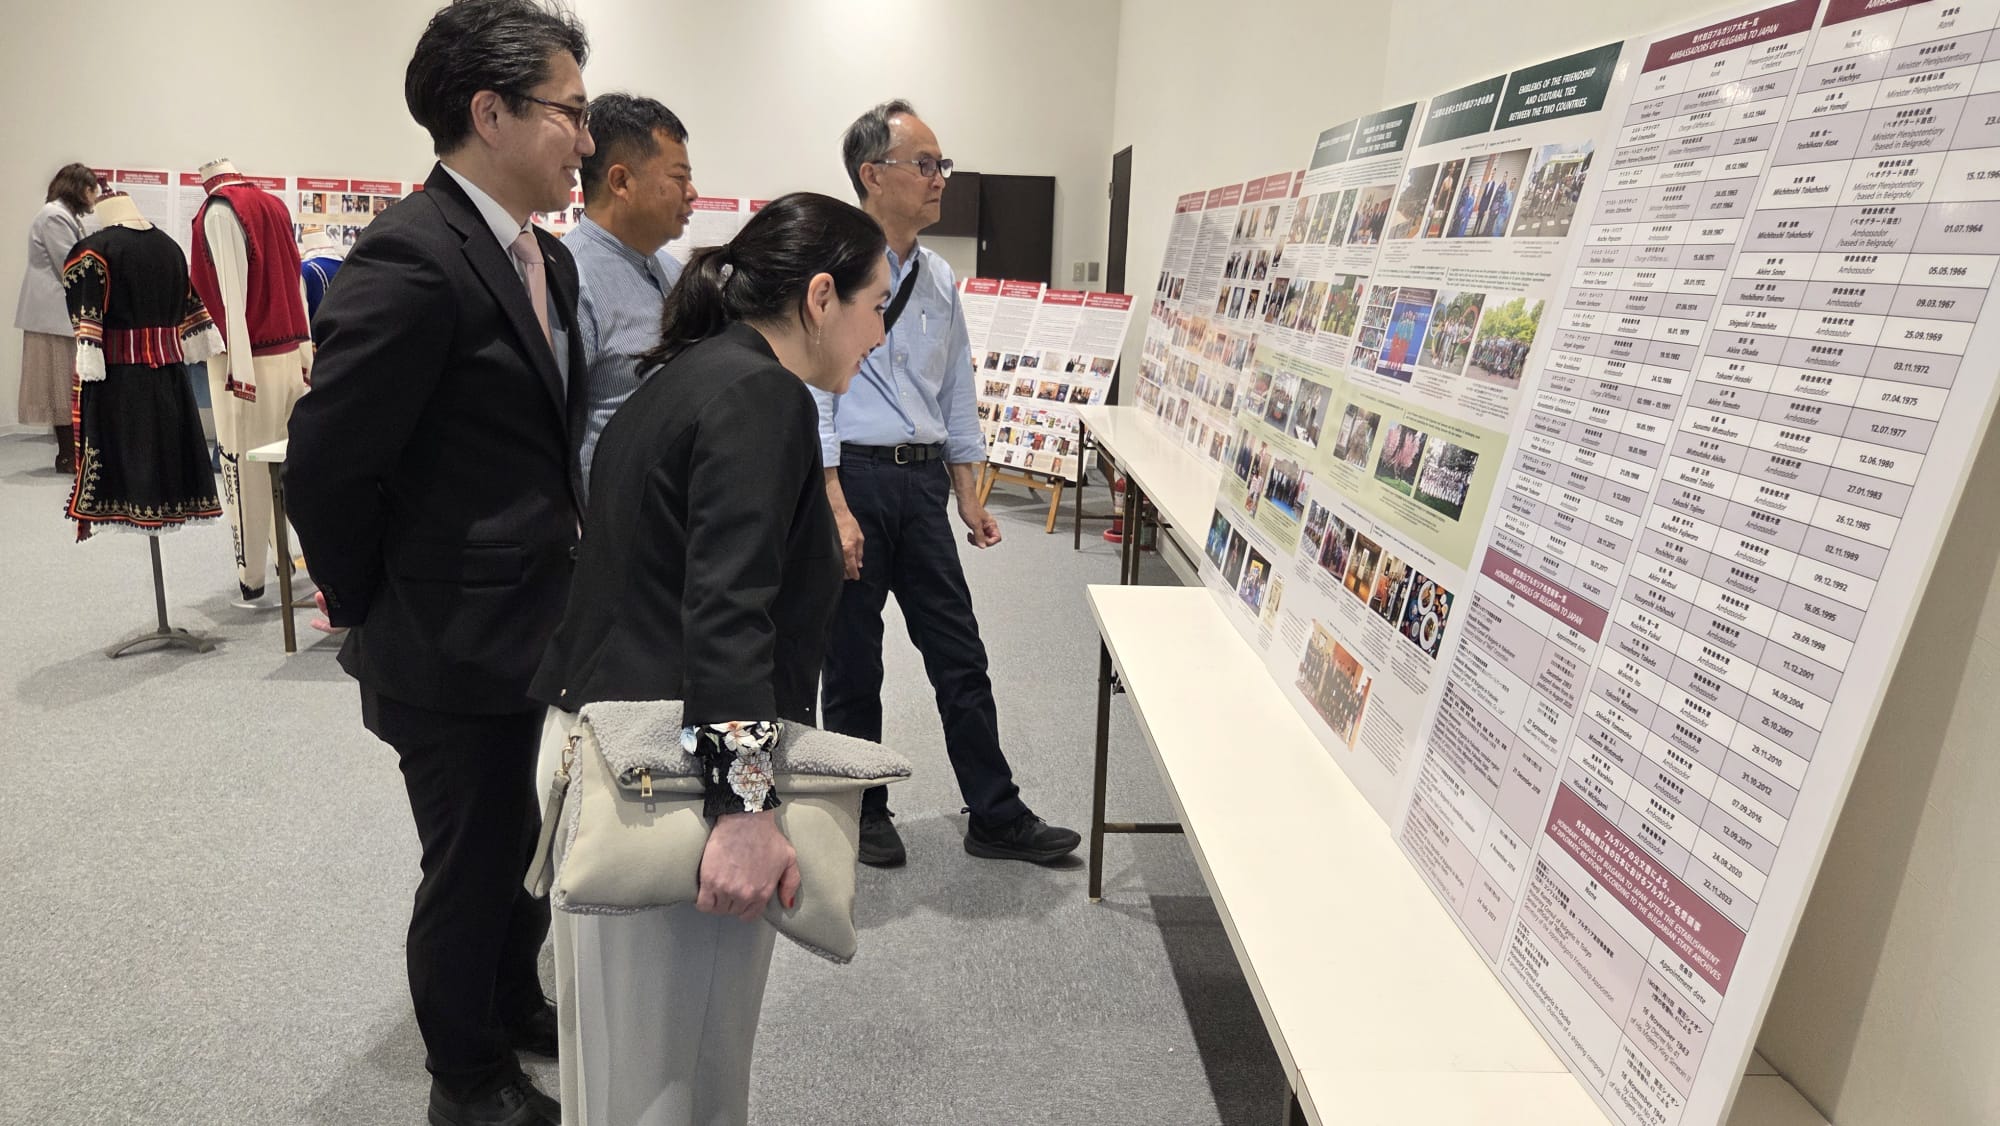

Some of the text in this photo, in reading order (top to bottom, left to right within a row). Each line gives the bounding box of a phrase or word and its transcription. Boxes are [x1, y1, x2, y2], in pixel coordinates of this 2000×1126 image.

[1671, 44, 1709, 60] AMBASSADORS
[1709, 39, 1719, 50] OF
[1718, 32, 1747, 47] BULGARIA
[1747, 28, 1758, 40] TO
[1757, 23, 1779, 38] JAPAN
[1518, 67, 1596, 95] EMBLEMS OF THE FRIENDSHIP
[1525, 85, 1577, 105] AND CULTURAL TIES
[1508, 97, 1588, 121] BETWEEN THE TWO COUNTRIES
[1851, 228, 1888, 237] Ambassador
[1944, 224, 1983, 232] 01.07.1964
[1838, 266, 1874, 274] Ambassador
[1928, 266, 1967, 275] 05.05.1966
[1825, 298, 1862, 307] Ambassador
[1916, 299, 1955, 308] 09.03.1967
[1815, 327, 1851, 337] Ambassador
[1904, 330, 1942, 341] 25.09.1969
[1804, 356, 1840, 367] Ambassador
[1893, 362, 1929, 373] 03.11.1972
[1794, 385, 1829, 396] Ambassador
[1881, 393, 1918, 405] 07.04.1975
[1783, 413, 1818, 425] Ambassador
[1871, 424, 1906, 437] 12.07.1977
[1773, 441, 1807, 454] Ambassador
[1859, 454, 1894, 468] 12.06.1980
[1764, 466, 1798, 479] Ambassador
[1847, 484, 1882, 500] 27.01.1983
[1753, 496, 1786, 511] Ambassador
[1745, 520, 1777, 535] Ambassador
[1835, 514, 1870, 531] 26.12.1985
[1734, 550, 1766, 566] Ambassador
[1825, 544, 1859, 561] 02.11.1989
[1725, 577, 1756, 593] Ambassador
[1814, 574, 1847, 592] 09.12.1992
[1494, 569, 1516, 585] HONORARY
[1514, 580, 1534, 596] CONSULS
[1538, 594, 1560, 612] BULGARIA
[1566, 611, 1583, 625] JAPAN
[1716, 603, 1746, 621] Ambassador
[1804, 603, 1836, 621] 16.05.1995
[1706, 630, 1736, 648] Ambassador
[1792, 631, 1825, 651] 29.09.1998
[1697, 656, 1727, 674] Ambassador
[1783, 660, 1814, 680] 11.12.2001
[1688, 682, 1717, 701] Ambassador
[1772, 688, 1804, 709] 14.09.2004
[1679, 707, 1708, 727] Ambassador
[1761, 716, 1793, 737] 25.10.2007
[1670, 733, 1699, 753] Ambassador
[1751, 744, 1782, 766] 29.11.2010
[1662, 758, 1690, 780] Ambassador
[1741, 772, 1772, 795] 31.10.2012
[1653, 782, 1681, 804] Ambassador
[1645, 807, 1672, 830] Ambassador
[1731, 799, 1761, 823] 07.09.2016
[1636, 832, 1663, 855] Ambassador
[1723, 825, 1752, 849] 12.09.2017
[1712, 852, 1742, 878] 24.08.2020
[1556, 819, 1579, 840] HONORARY
[1577, 838, 1597, 857] CONSULS
[1602, 860, 1625, 883] BULGARIA
[1631, 886, 1648, 903] JAPAN
[1646, 900, 1663, 917] AFTER
[1663, 913, 1675, 927] THE
[1674, 923, 1719, 965] ESTABLISHMENT
[1584, 886, 1596, 900] Name
[1703, 879, 1732, 905] 22.11.2023
[1556, 829, 1580, 853] DIPLOMATIC
[1579, 850, 1602, 875] RELATIONS,
[1602, 872, 1630, 899] ACCORDING
[1637, 902, 1648, 915] THE
[1646, 912, 1676, 940] BULGARIAN
[1675, 937, 1693, 955] STATE
[1691, 953, 1721, 980] ARCHIVES
[1659, 959, 1705, 1004] Appointment date
[1649, 1013, 1675, 1041] November
[1676, 1040, 1689, 1056] 1943
[1650, 1026, 1666, 1044] Decree
[1627, 1078, 1652, 1108] November
[1653, 1107, 1666, 1124] 1943
